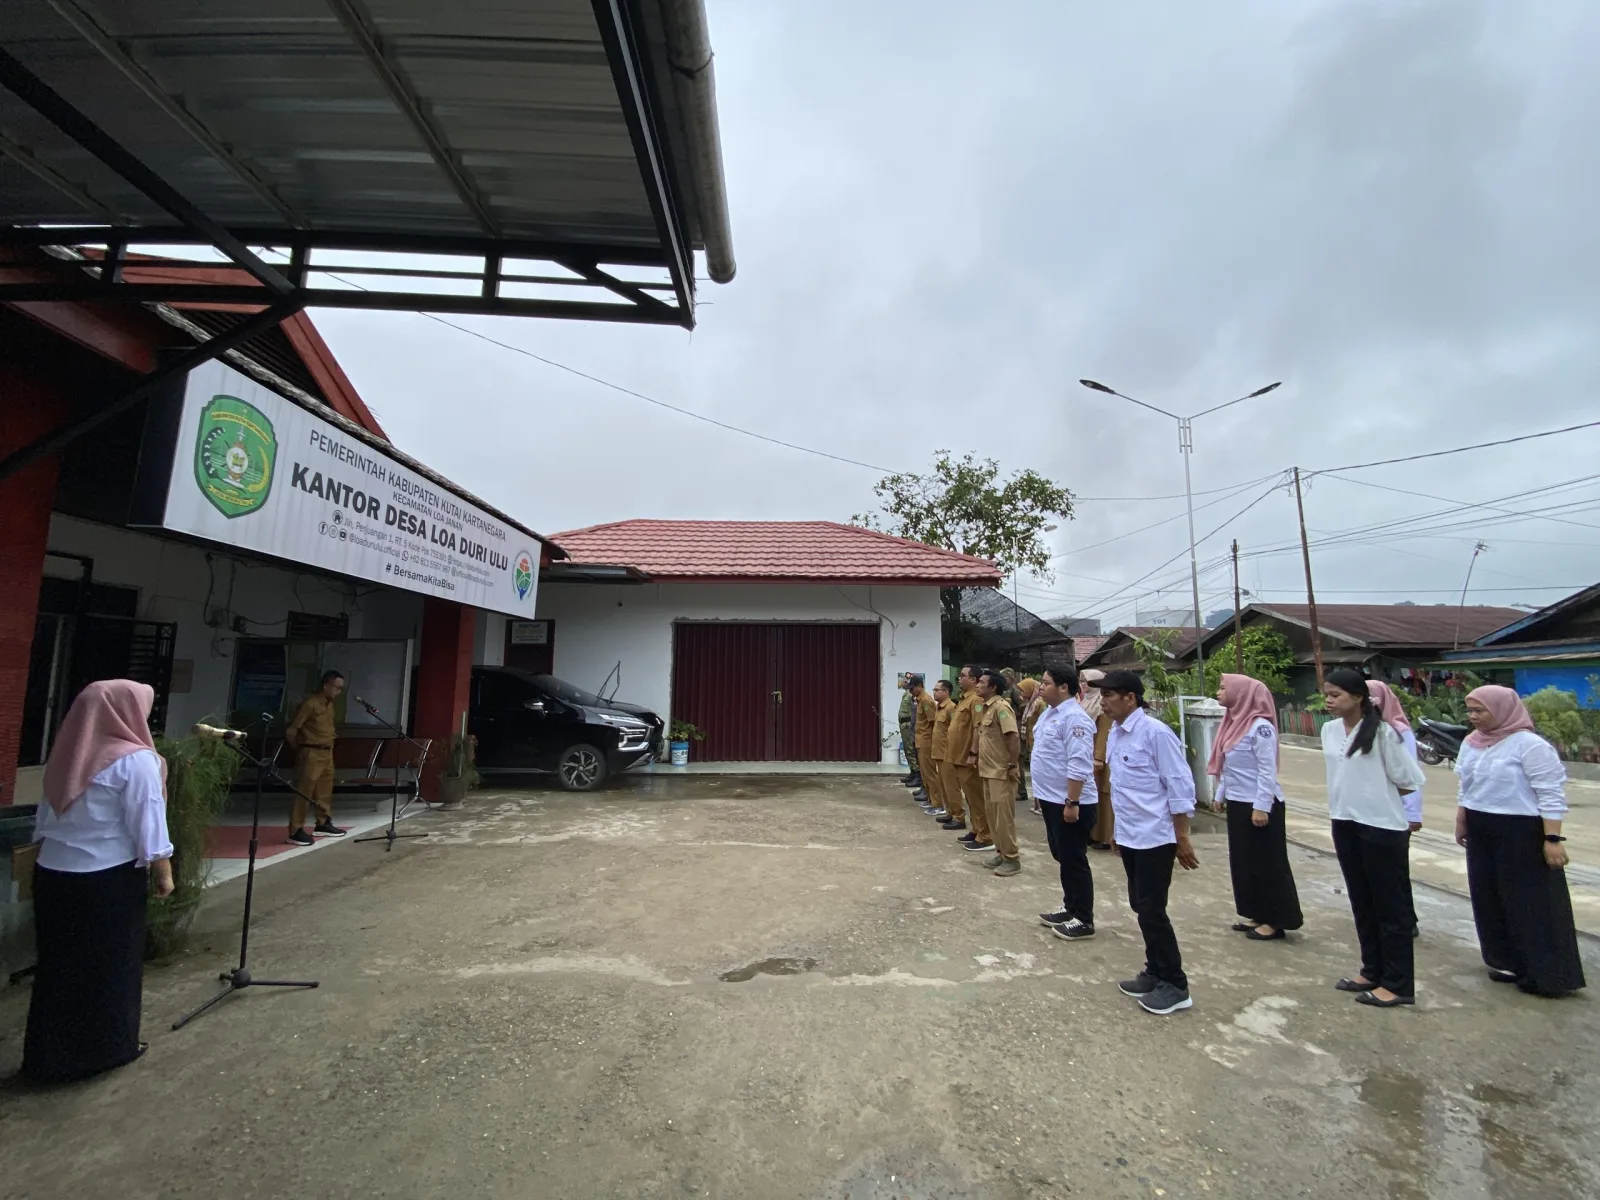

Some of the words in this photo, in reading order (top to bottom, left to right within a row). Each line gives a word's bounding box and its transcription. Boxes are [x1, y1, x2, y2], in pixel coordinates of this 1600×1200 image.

[309, 429, 386, 482] PEMERINTAH
[388, 471, 440, 509] KABUPATEN
[441, 498, 462, 518] KUTAI
[463, 512, 506, 542] KARTANEGARA
[291, 461, 381, 521] KANTOR
[384, 504, 427, 540] DESA
[430, 524, 456, 552] LOA
[459, 537, 487, 563] DURI
[489, 549, 509, 571] ULU
[393, 491, 432, 518] KECAMATAN
[433, 511, 445, 523] LOA
[445, 516, 463, 532] JANAN
[421, 545, 430, 556] Pos
[385, 562, 392, 573] #
[393, 564, 455, 591] BersamaKitaBisa
